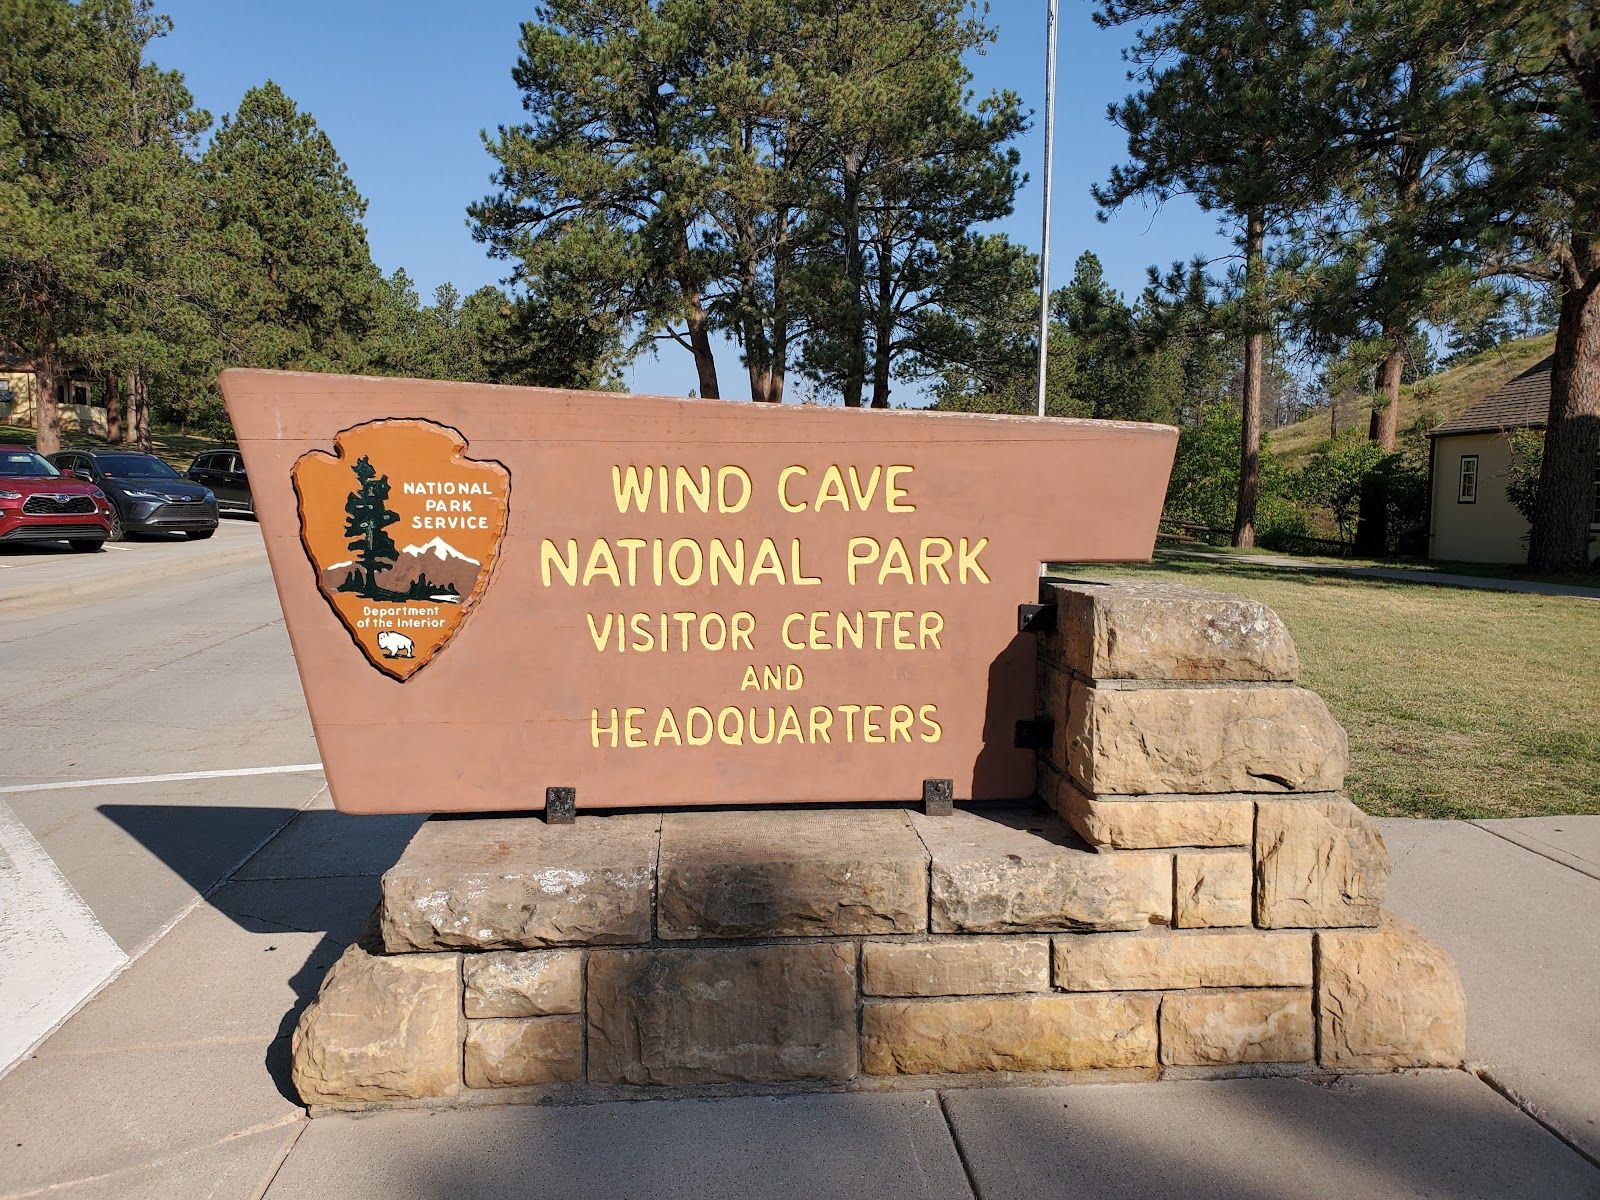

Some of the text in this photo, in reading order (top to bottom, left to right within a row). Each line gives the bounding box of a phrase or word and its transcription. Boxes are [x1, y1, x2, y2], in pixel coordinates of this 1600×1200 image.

[403, 481, 493, 496] NATIONAL
[611, 464, 916, 514] WIND CAVE
[425, 499, 473, 513] PARK
[411, 516, 489, 530] SERVICE
[539, 537, 991, 588] NATIONAL PARK
[363, 605, 440, 618] Department
[356, 617, 446, 629] of the Interior
[586, 610, 944, 653] VISITOR CENTER
[740, 664, 804, 692] AND
[590, 704, 942, 749] HEADQUARTERS
